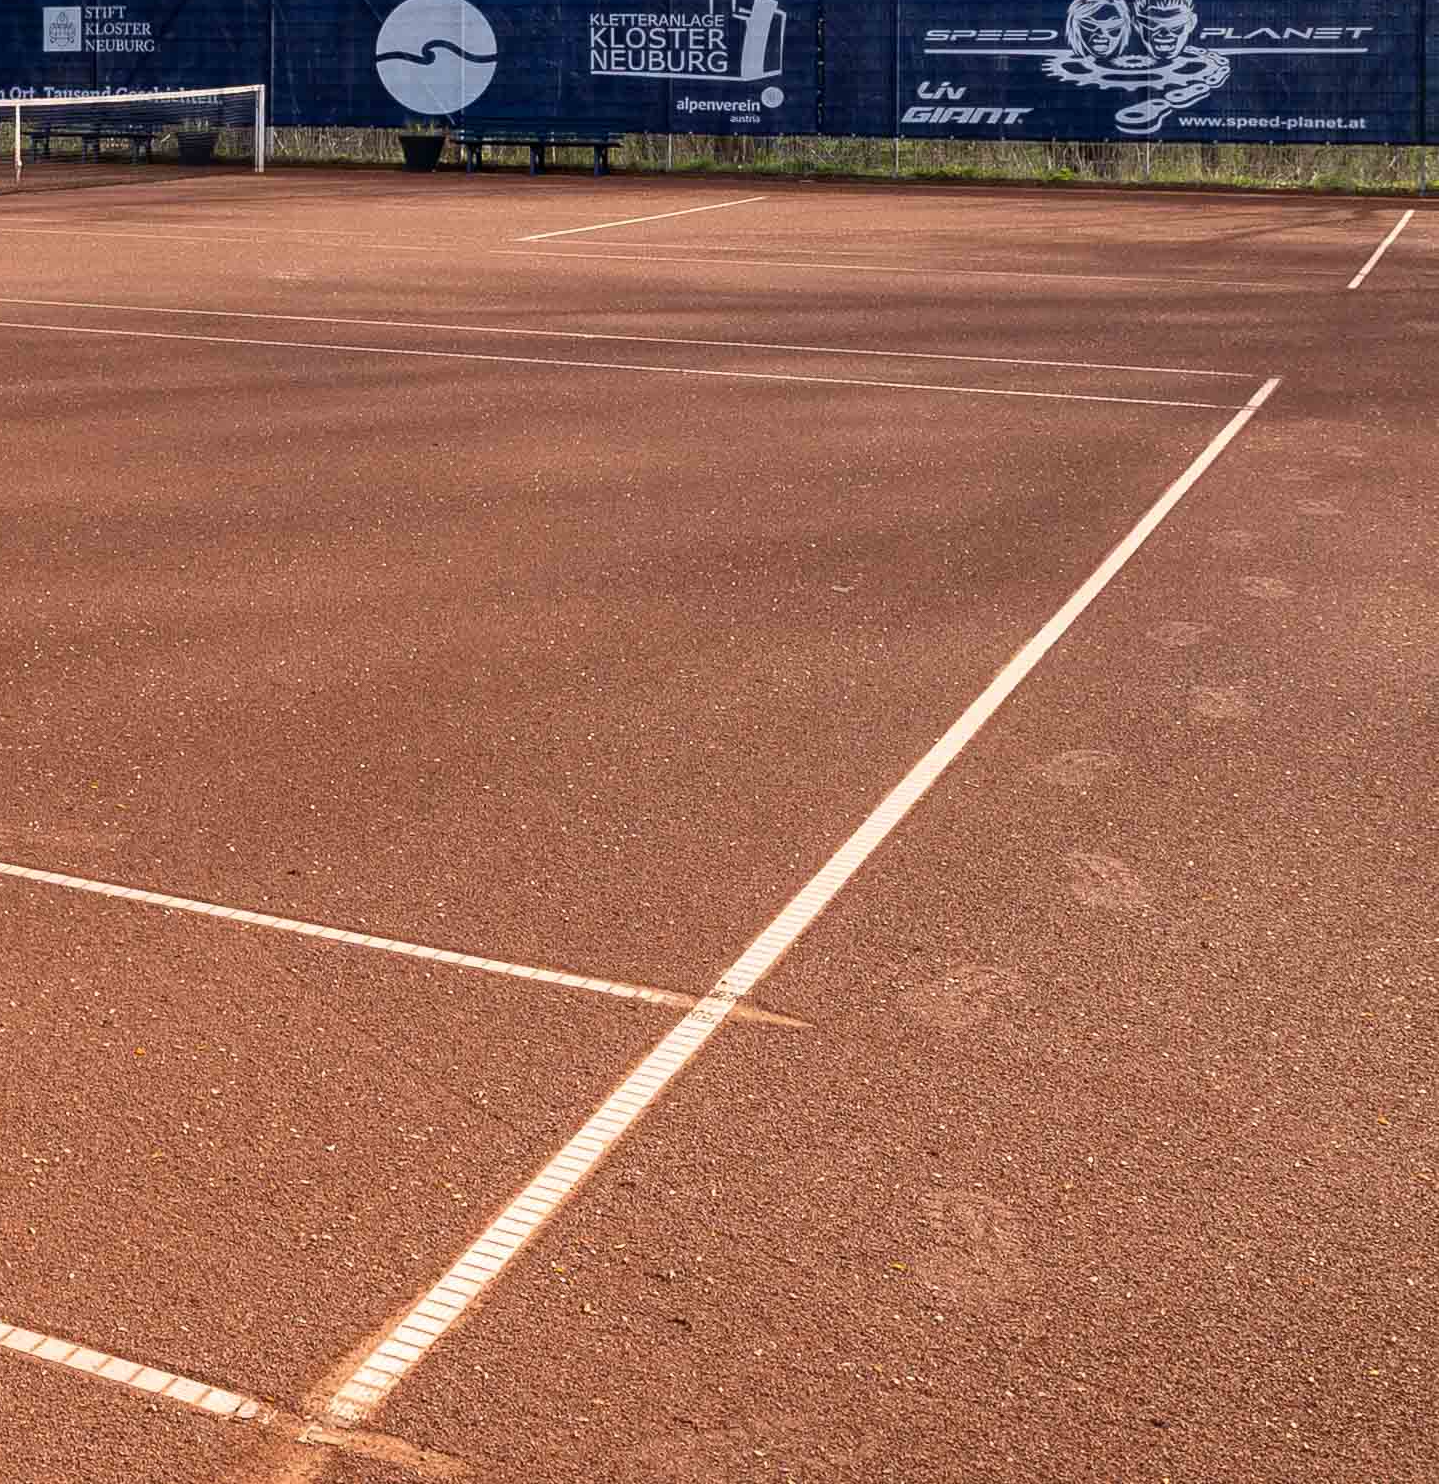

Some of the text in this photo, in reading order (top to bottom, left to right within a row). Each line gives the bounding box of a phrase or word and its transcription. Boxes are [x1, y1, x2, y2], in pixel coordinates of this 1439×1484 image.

[84, 5, 127, 19] STIFT
[589, 13, 725, 27] KLETTERANLAGE
[85, 21, 152, 36] KLOSTER
[924, 27, 1373, 41] SPEED PLANET
[85, 38, 155, 53] NEUBURG
[590, 27, 727, 50] KLOSTER
[590, 49, 728, 73] NEUBURG
[917, 81, 967, 100] Liv
[676, 96, 761, 114] alpenverein
[1178, 115, 1366, 130] www.speed-planet.at
